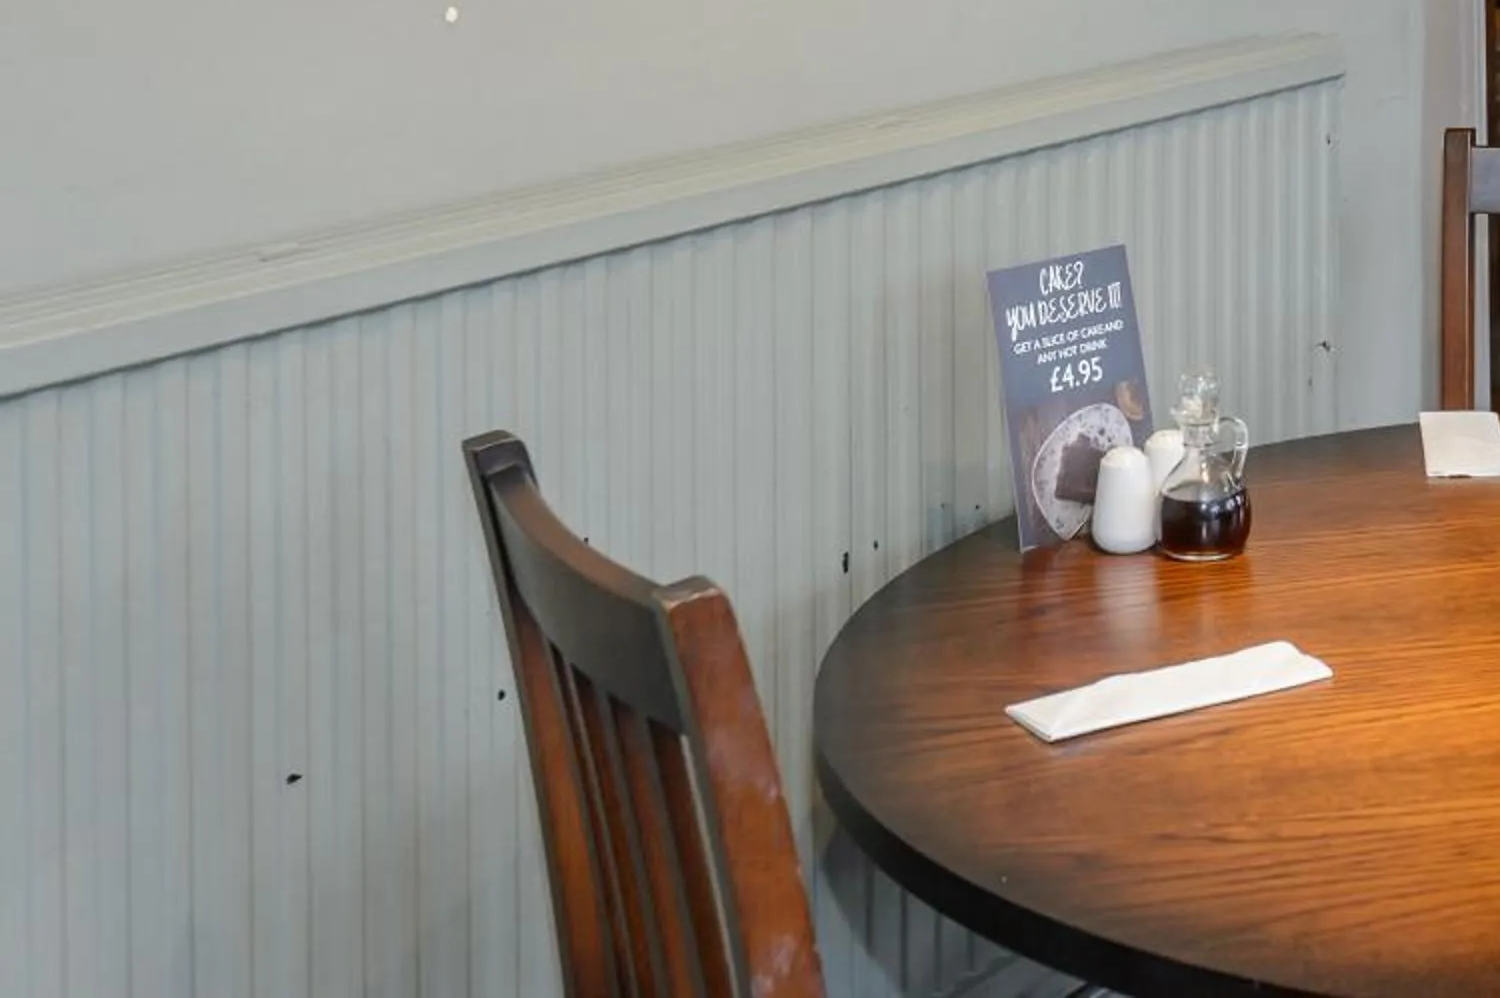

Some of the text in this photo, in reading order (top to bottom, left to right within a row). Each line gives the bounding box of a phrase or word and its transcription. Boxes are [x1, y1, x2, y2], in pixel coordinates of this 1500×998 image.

[1039, 260, 1084, 296] CAKE?
[1037, 286, 1107, 326] DESERVE
[1013, 341, 1032, 355] GET
[1033, 338, 1042, 351] A
[1066, 329, 1079, 343] OF
[1080, 323, 1105, 339] CAKE
[1104, 318, 1124, 332] AND
[1058, 345, 1078, 359] HOT
[1050, 356, 1103, 392] £4.95
